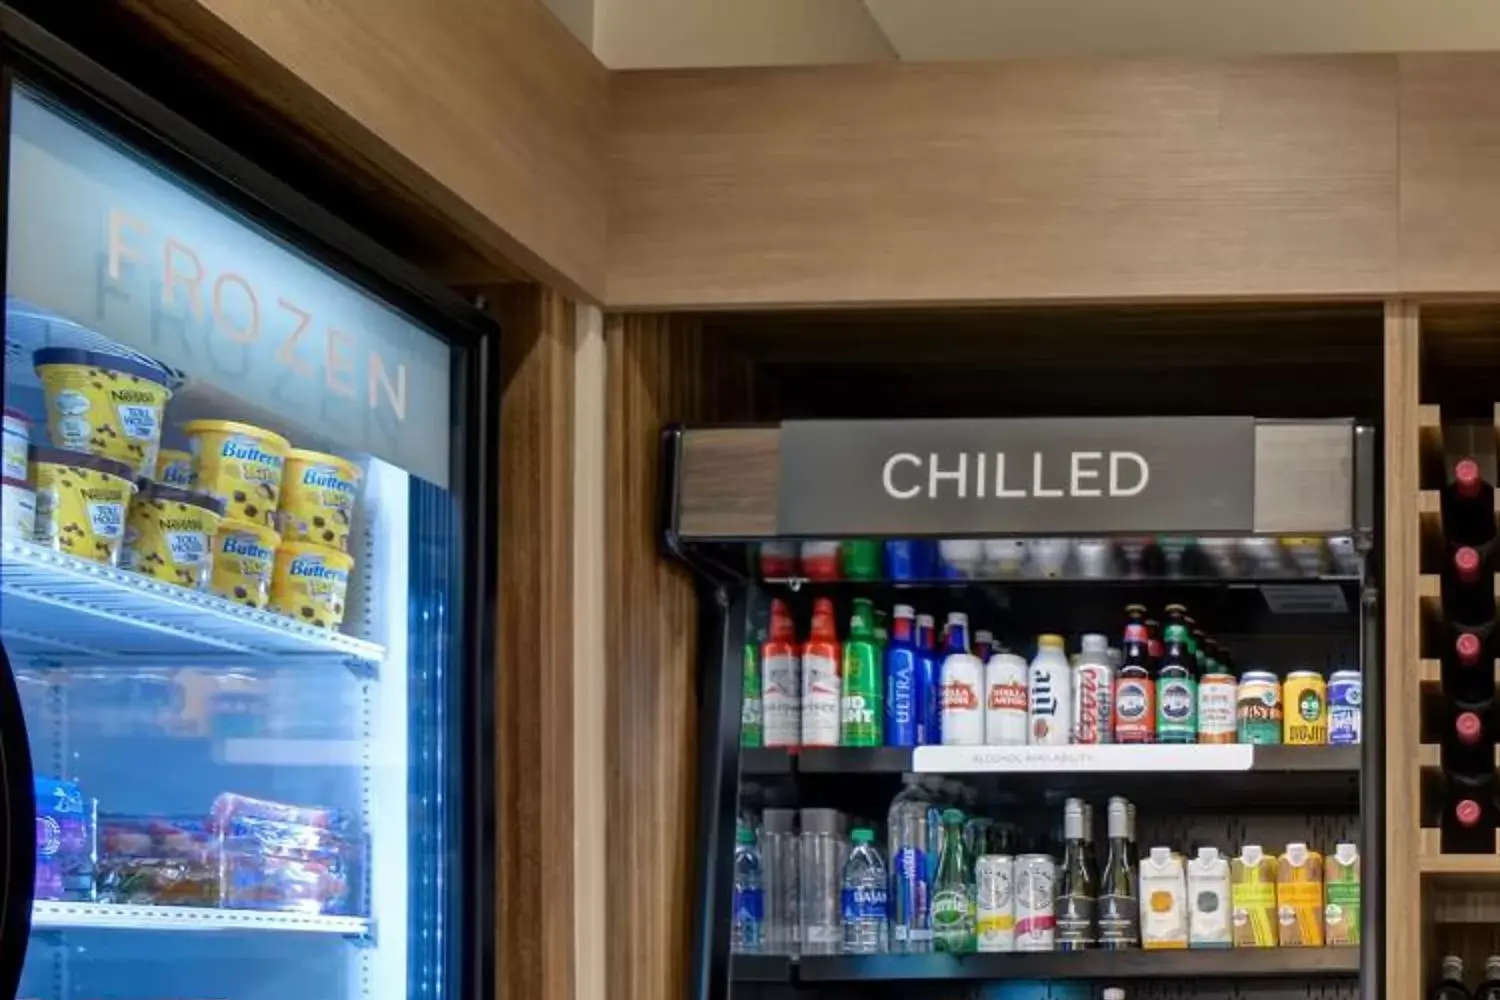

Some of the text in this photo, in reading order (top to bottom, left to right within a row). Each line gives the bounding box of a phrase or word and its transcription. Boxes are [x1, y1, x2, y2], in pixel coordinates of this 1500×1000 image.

[107, 207, 407, 419] FROZEN
[882, 452, 1150, 499] CHILLED
[895, 671, 911, 723] ULTRA
